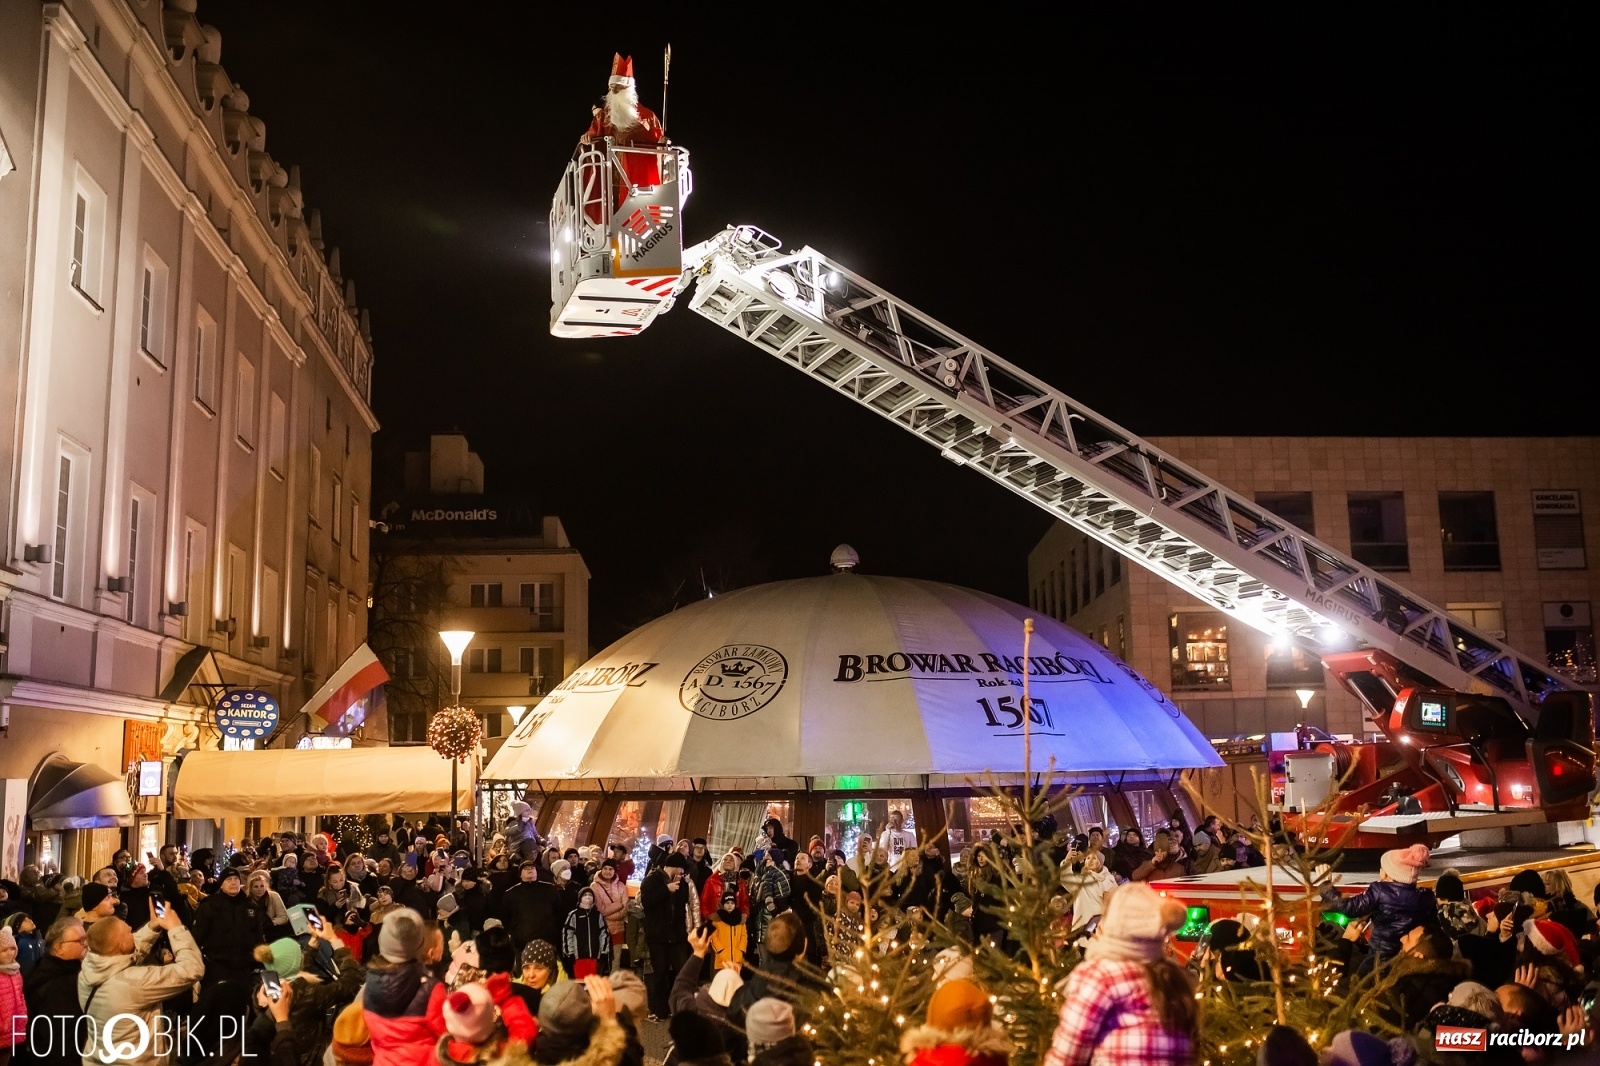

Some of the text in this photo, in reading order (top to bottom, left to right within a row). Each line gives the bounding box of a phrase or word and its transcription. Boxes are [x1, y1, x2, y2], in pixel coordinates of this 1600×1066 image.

[632, 222, 674, 262] MAGIRUS
[411, 508, 498, 521] McDonald's
[1304, 587, 1361, 626] MAGIRUS
[692, 646, 784, 675] BROWAR ZAMKOWY
[833, 652, 982, 683] BROWAR
[978, 651, 1114, 685] RACIBÓRZ
[731, 674, 777, 695] 1567
[977, 678, 1006, 688] Rok
[227, 708, 268, 719] KANTOR
[976, 695, 1056, 730] 1567
